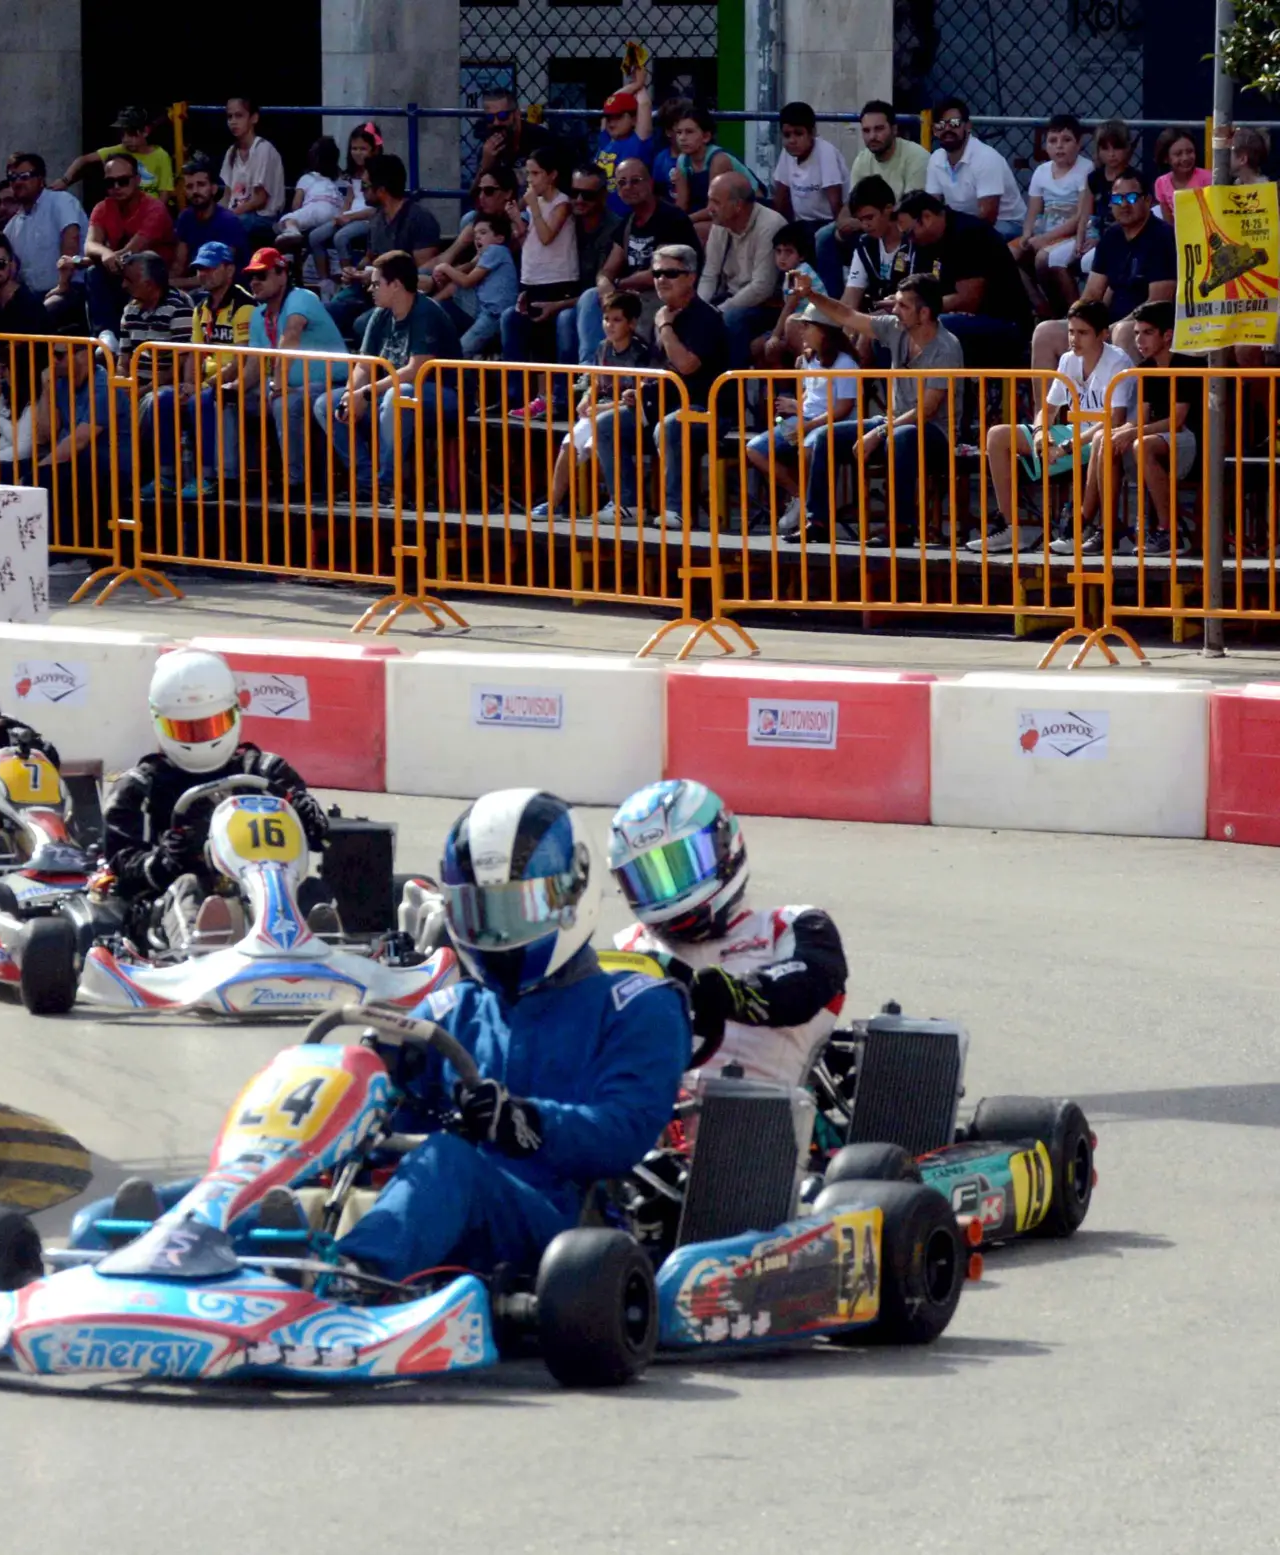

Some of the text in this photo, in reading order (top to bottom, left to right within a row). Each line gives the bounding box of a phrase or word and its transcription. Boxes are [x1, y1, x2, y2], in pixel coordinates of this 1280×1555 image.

[503, 695, 557, 717] AUTOVISION
[779, 710, 830, 731] AUTOVISION
[1040, 723, 1094, 739] ΔΟΥΡΟΣ
[23, 762, 42, 791] 7
[247, 817, 286, 849] 16
